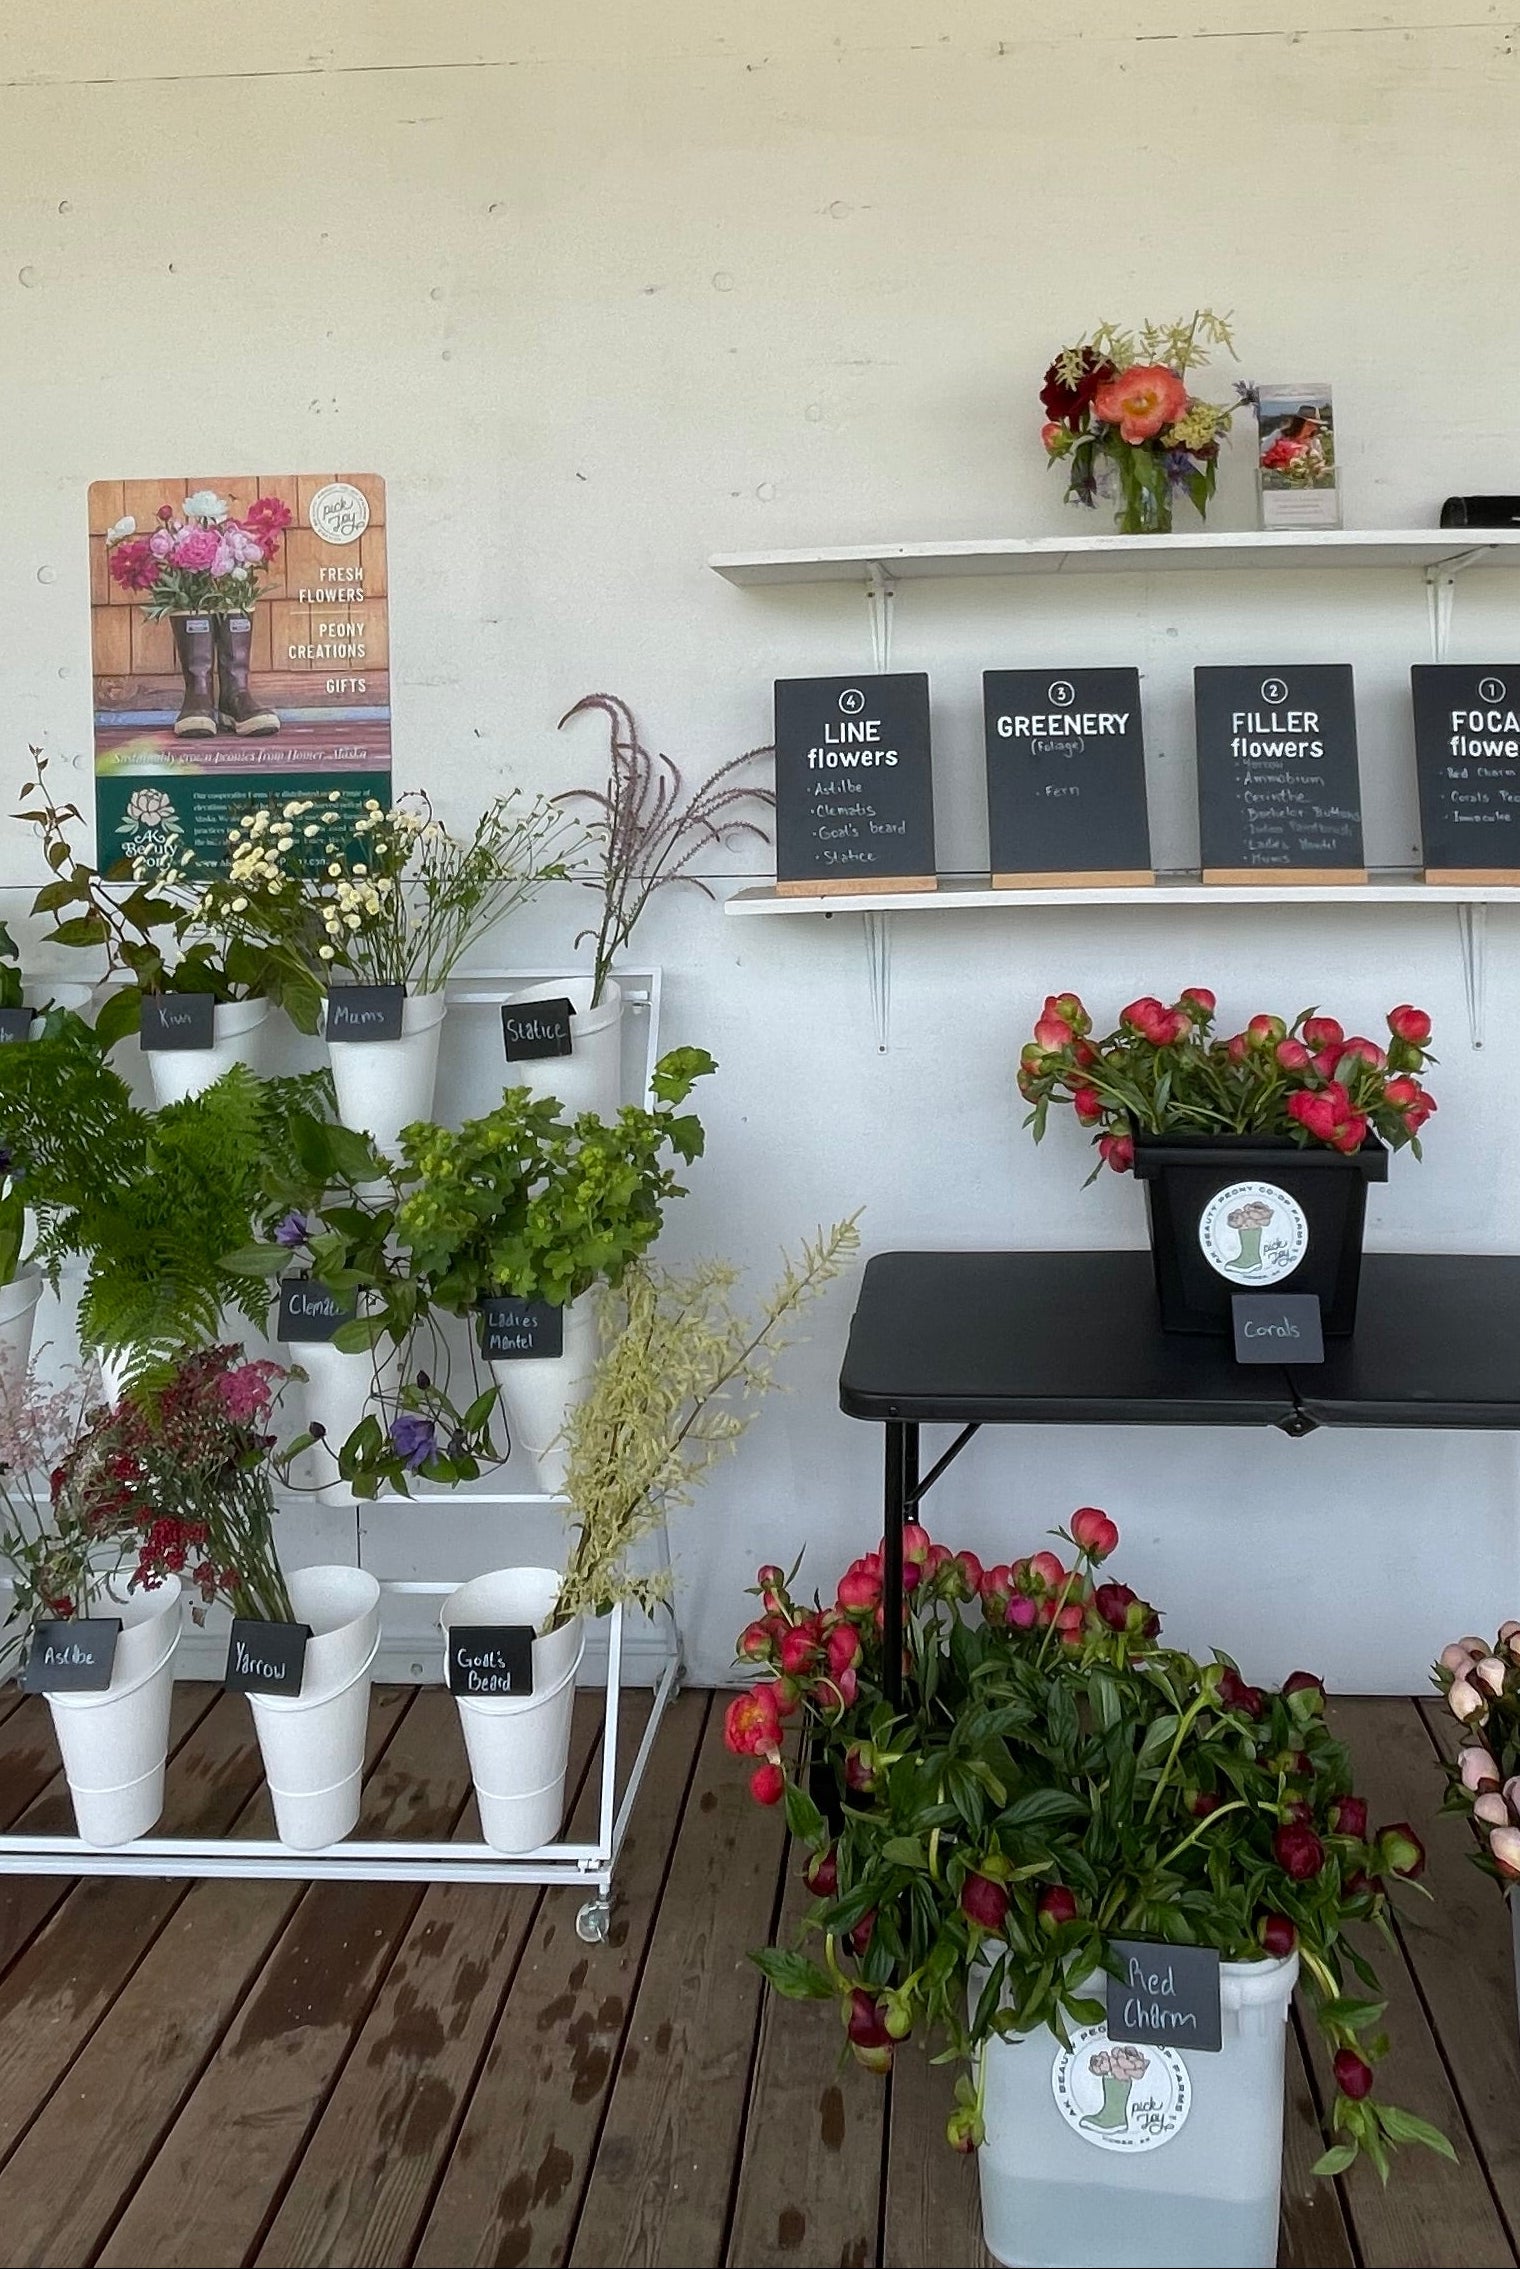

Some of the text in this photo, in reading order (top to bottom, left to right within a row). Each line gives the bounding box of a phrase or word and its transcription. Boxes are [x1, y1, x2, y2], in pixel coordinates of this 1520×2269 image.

[320, 567, 363, 582] FRESH
[299, 588, 364, 603] FLOWERS
[319, 623, 364, 638] PEONY
[288, 644, 366, 660] CREATIONS
[326, 678, 366, 694] GIFTS
[824, 720, 881, 744] LINE
[997, 713, 1130, 737] GREENERY
[1232, 711, 1320, 734] FILLER
[1451, 710, 1520, 733] FOCA
[1230, 738, 1325, 758] flowers
[1449, 735, 1520, 758] flowe
[807, 748, 900, 770] flowers
[814, 778, 862, 796] Astilbe
[1045, 784, 1080, 797] Fern
[816, 802, 877, 818] Clematis
[869, 820, 906, 835] beard
[121, 842, 178, 858] Beuty
[823, 848, 879, 865] Statice
[333, 1005, 385, 1025] Mums
[506, 1018, 567, 1042] Statice
[1204, 1205, 1217, 1247] BEAUTY
[1217, 1186, 1253, 1204] PEONY
[1258, 1186, 1291, 1206] CO-OP
[1291, 1209, 1303, 1246] FARMS
[488, 1311, 538, 1328] Ladies
[1243, 1315, 1300, 1338] Corals
[489, 1333, 533, 1350] Mantel
[235, 1641, 286, 1679] Yarrow
[468, 1669, 512, 1692] Beard
[1129, 1956, 1177, 1997] Red
[1123, 1998, 1197, 2030] Charm
[1080, 2025, 1107, 2041] PEO
[1172, 2064, 1186, 2112] FARMS
[1131, 2096, 1163, 2118] pick
[1136, 2112, 1176, 2135] Joy
